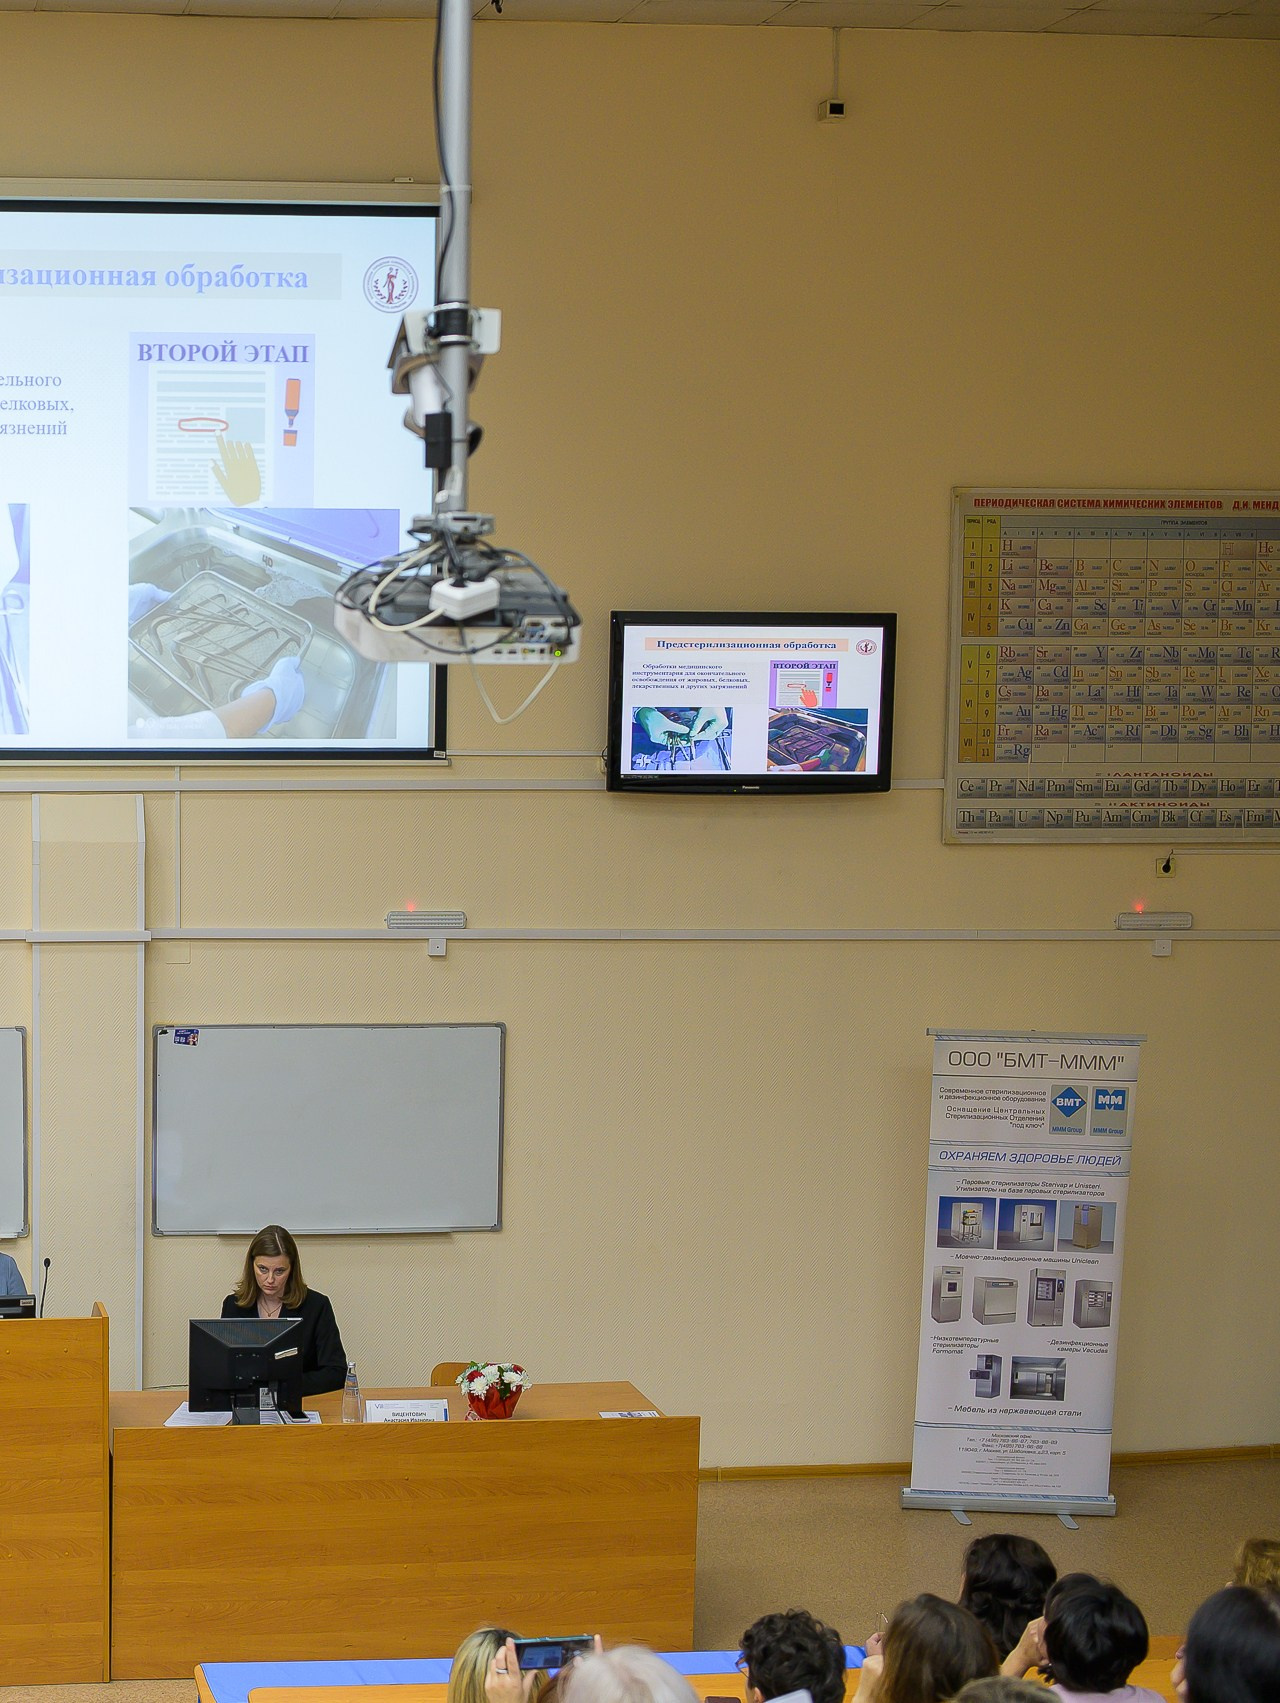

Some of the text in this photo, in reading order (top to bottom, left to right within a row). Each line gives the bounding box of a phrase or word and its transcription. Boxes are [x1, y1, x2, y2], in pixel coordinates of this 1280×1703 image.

[165, 263, 308, 293] обработка
[138, 339, 310, 363] ВТОРОЙ ЭТАП
[974, 498, 1055, 509] ПЕРИОДИЧЕСКАЯ
[1057, 498, 1101, 508] СИСТЕМА
[1103, 499, 1165, 509] ХИМИЧЕСКИХ
[1167, 500, 1223, 509] ЭЛЕМЕНТОВ
[1002, 539, 1273, 553] H He
[1002, 559, 1013, 571] Li
[1040, 559, 1053, 571] Be
[1113, 560, 1122, 571] C
[1149, 560, 1159, 571] N
[1222, 560, 1230, 571] F
[1258, 560, 1273, 572] Ne
[657, 640, 837, 650] Предстерилизационная обработка
[773, 662, 810, 670] ВТОРОЙ
[959, 780, 1260, 794] Ce Pr Nd Pm Sm Eu Gd Tb Dy Ho Er
[948, 1051, 991, 1067] ООО
[939, 1087, 984, 1095] Современное
[946, 1105, 991, 1113] Оснащение
[945, 1112, 1044, 1122] Стерилизационных Отделений
[1067, 1126, 1082, 1134] Group
[939, 1151, 1122, 1166] ОХРАНЯЕМ ЗДОРОВЬЕ ЛЮДЕЙ
[955, 1185, 997, 1193] Утилизаторы
[991, 1180, 1040, 1188] стерилизаторы
[954, 1404, 985, 1413] Мебель
[999, 1408, 1056, 1416] нержавеющей
